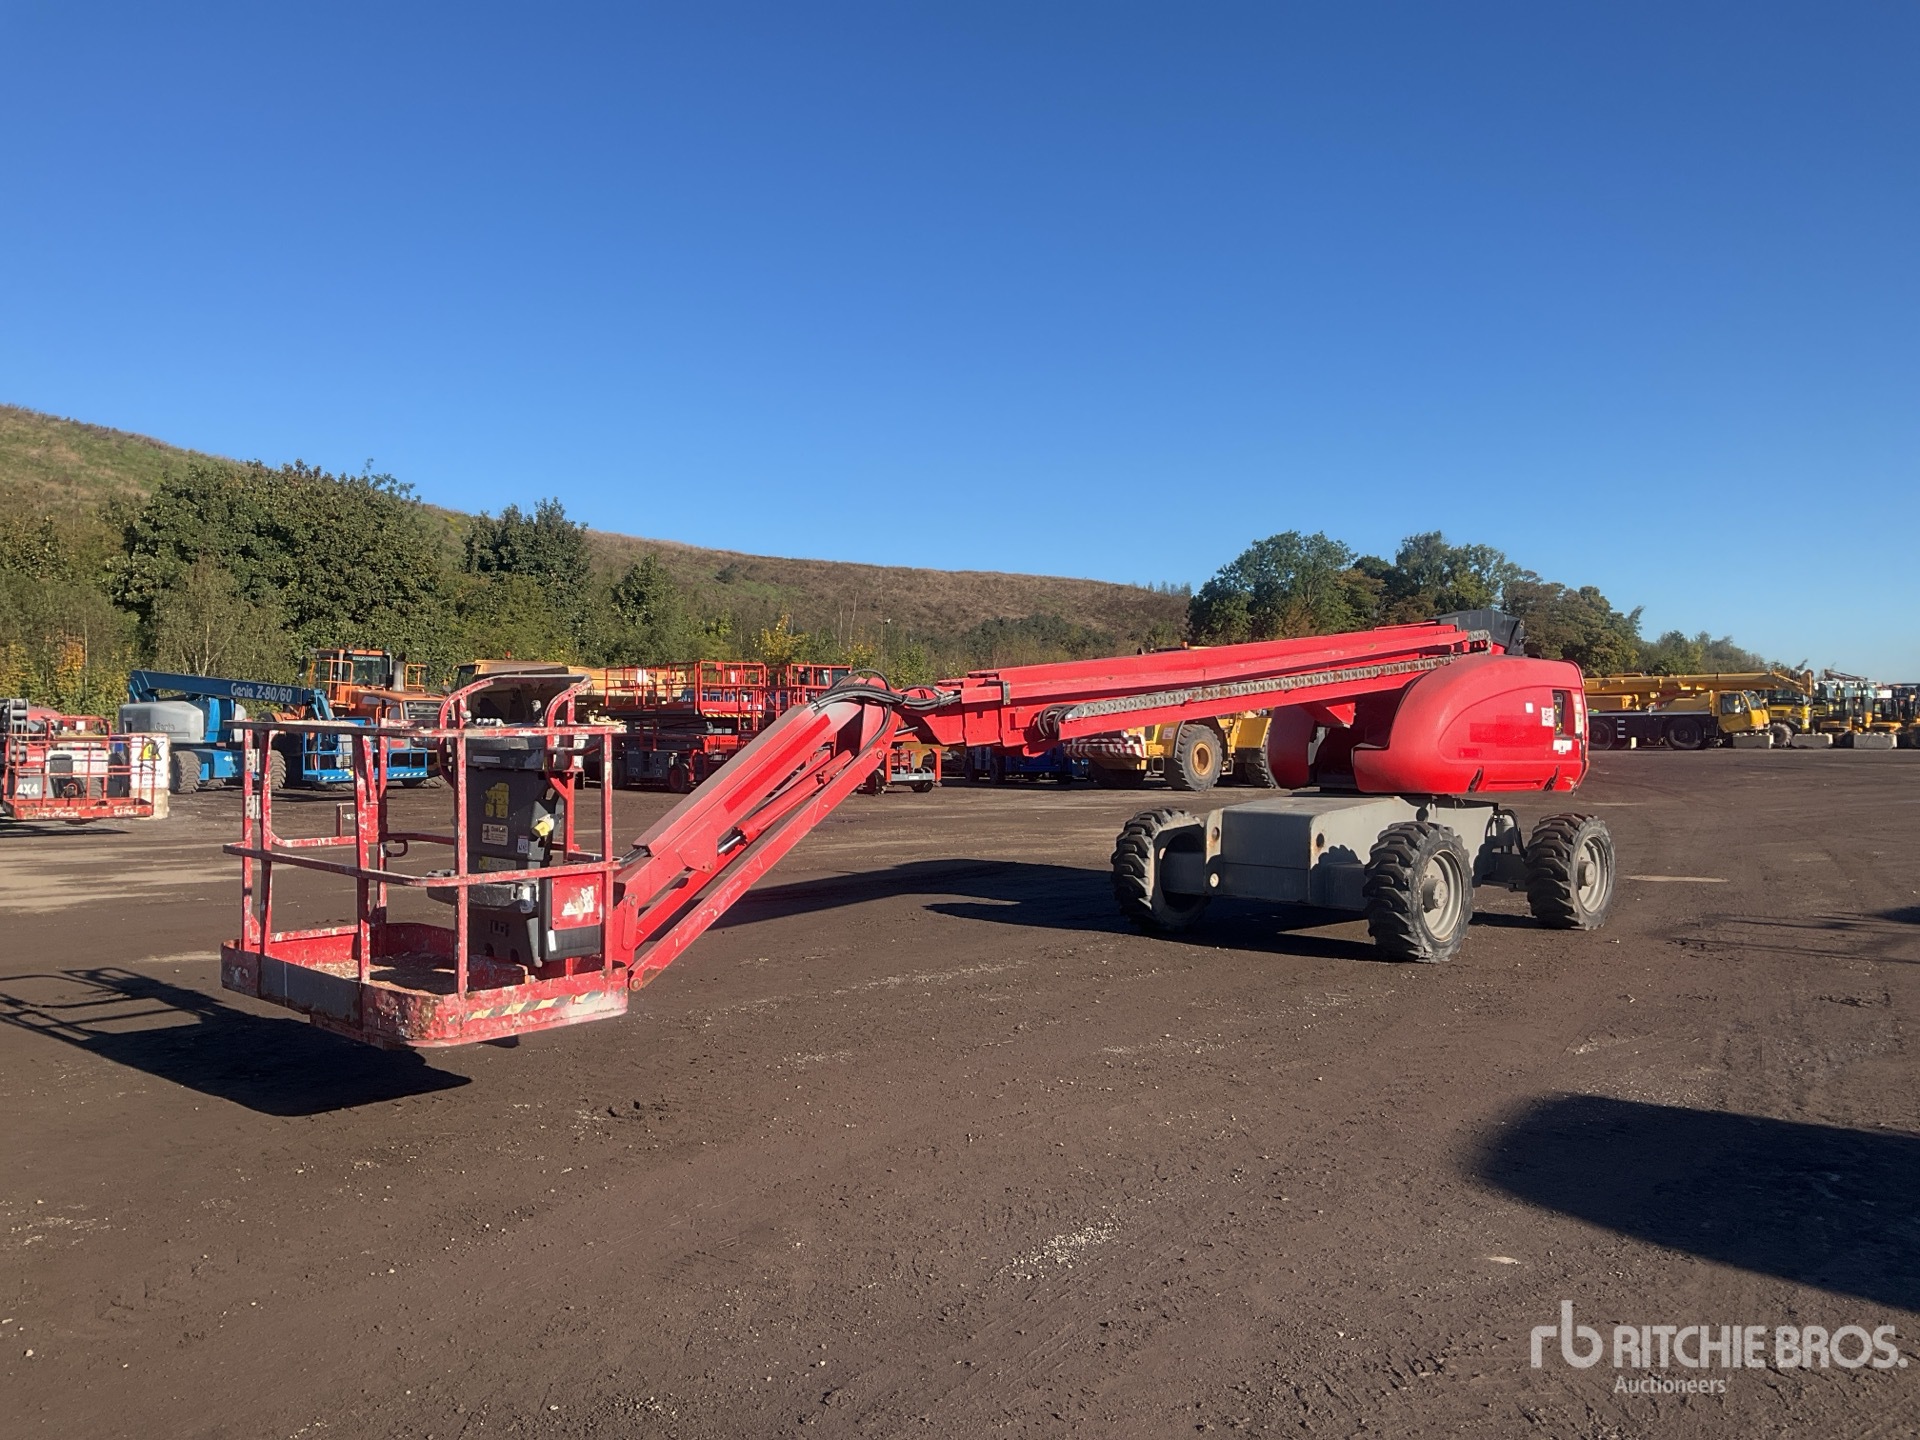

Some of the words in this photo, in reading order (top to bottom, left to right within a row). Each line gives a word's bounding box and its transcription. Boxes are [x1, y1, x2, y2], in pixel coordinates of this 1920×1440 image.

[230, 682, 254, 696] Genie
[256, 684, 293, 702] Z-80/60
[15, 783, 39, 795] 4X4
